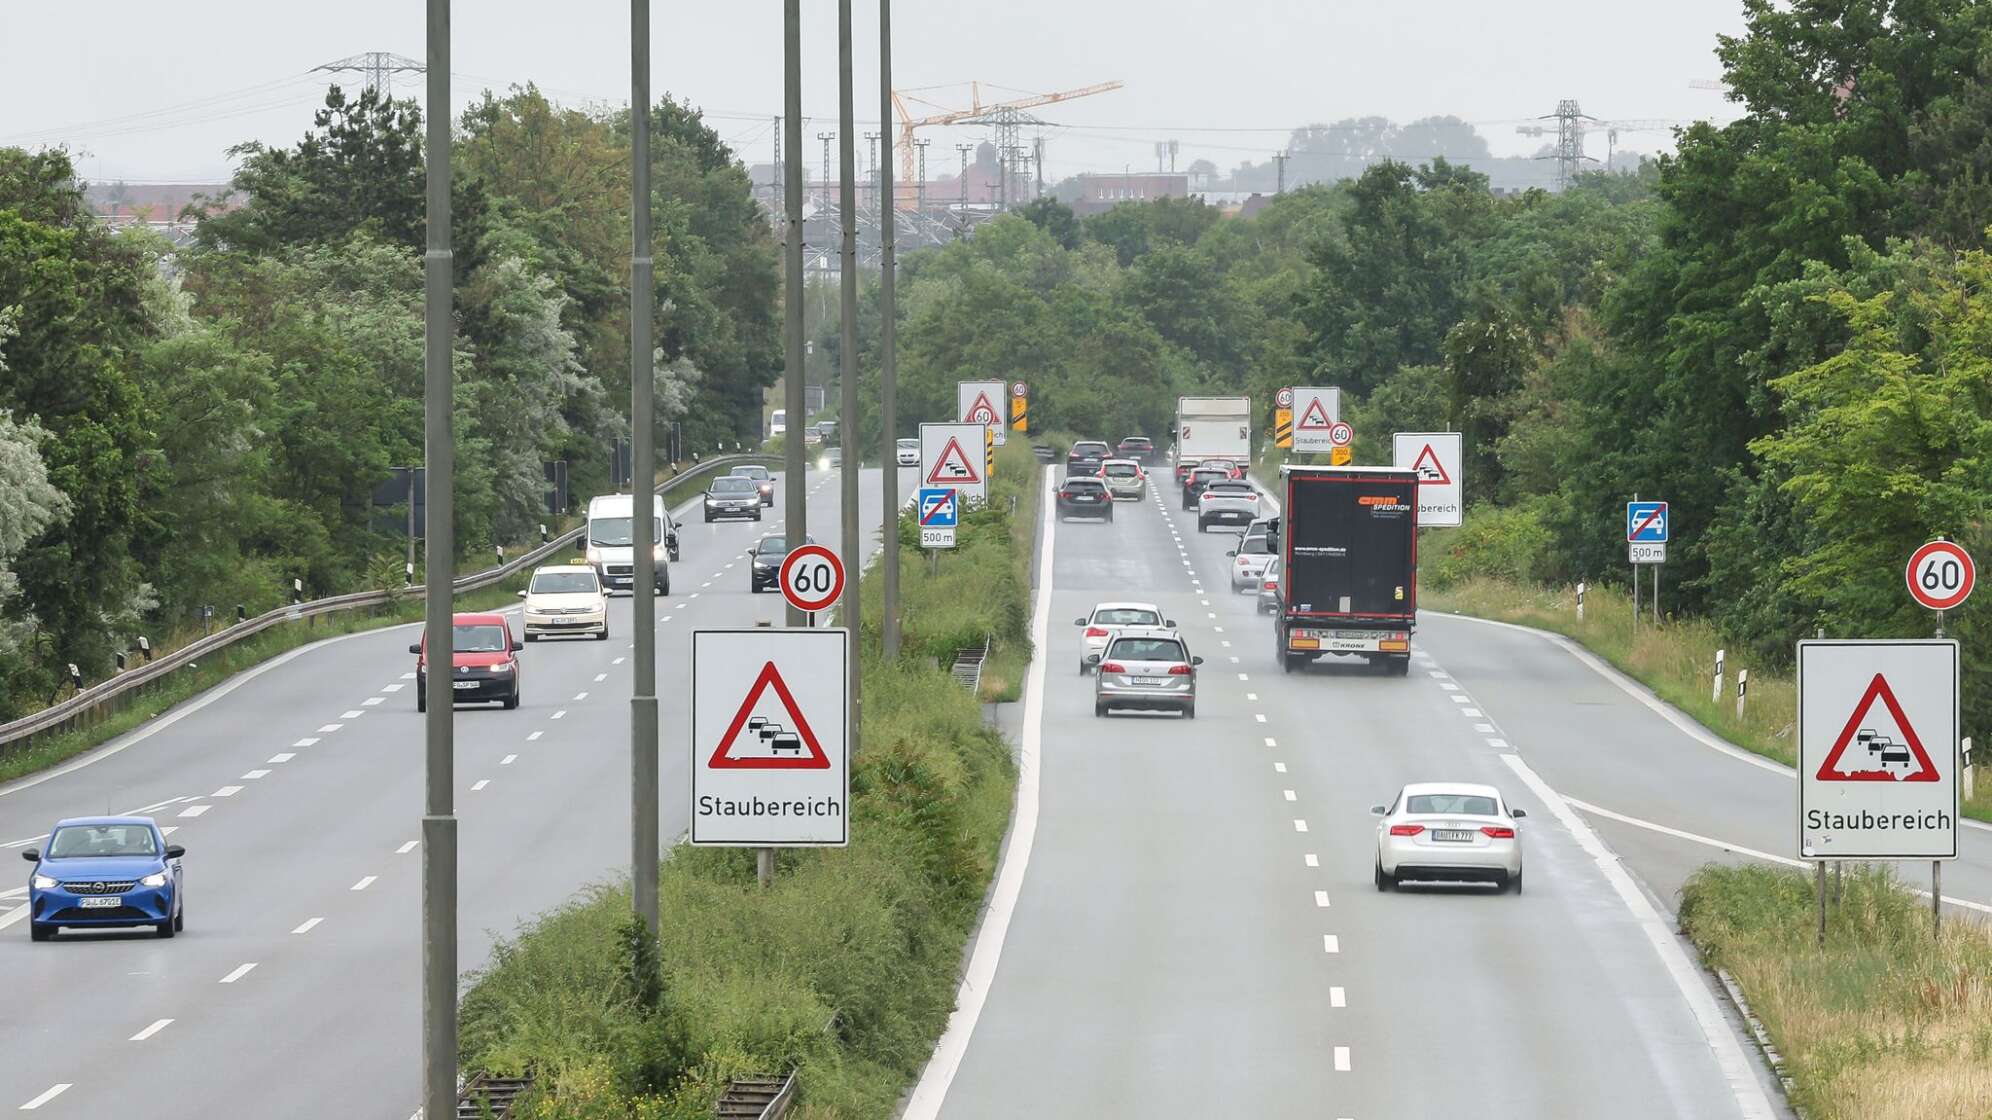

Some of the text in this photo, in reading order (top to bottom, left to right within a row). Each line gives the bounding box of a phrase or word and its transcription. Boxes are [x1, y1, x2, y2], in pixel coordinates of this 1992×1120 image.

[976, 411, 989, 422] 60
[1334, 429, 1347, 440] 60
[1418, 504, 1457, 512] bereich
[923, 532, 941, 542] 500
[1633, 548, 1651, 557] 500
[794, 564, 831, 593] 60
[1922, 560, 1959, 590] 60
[699, 796, 840, 817] Staubereich
[1807, 809, 1950, 830] Staubereich
